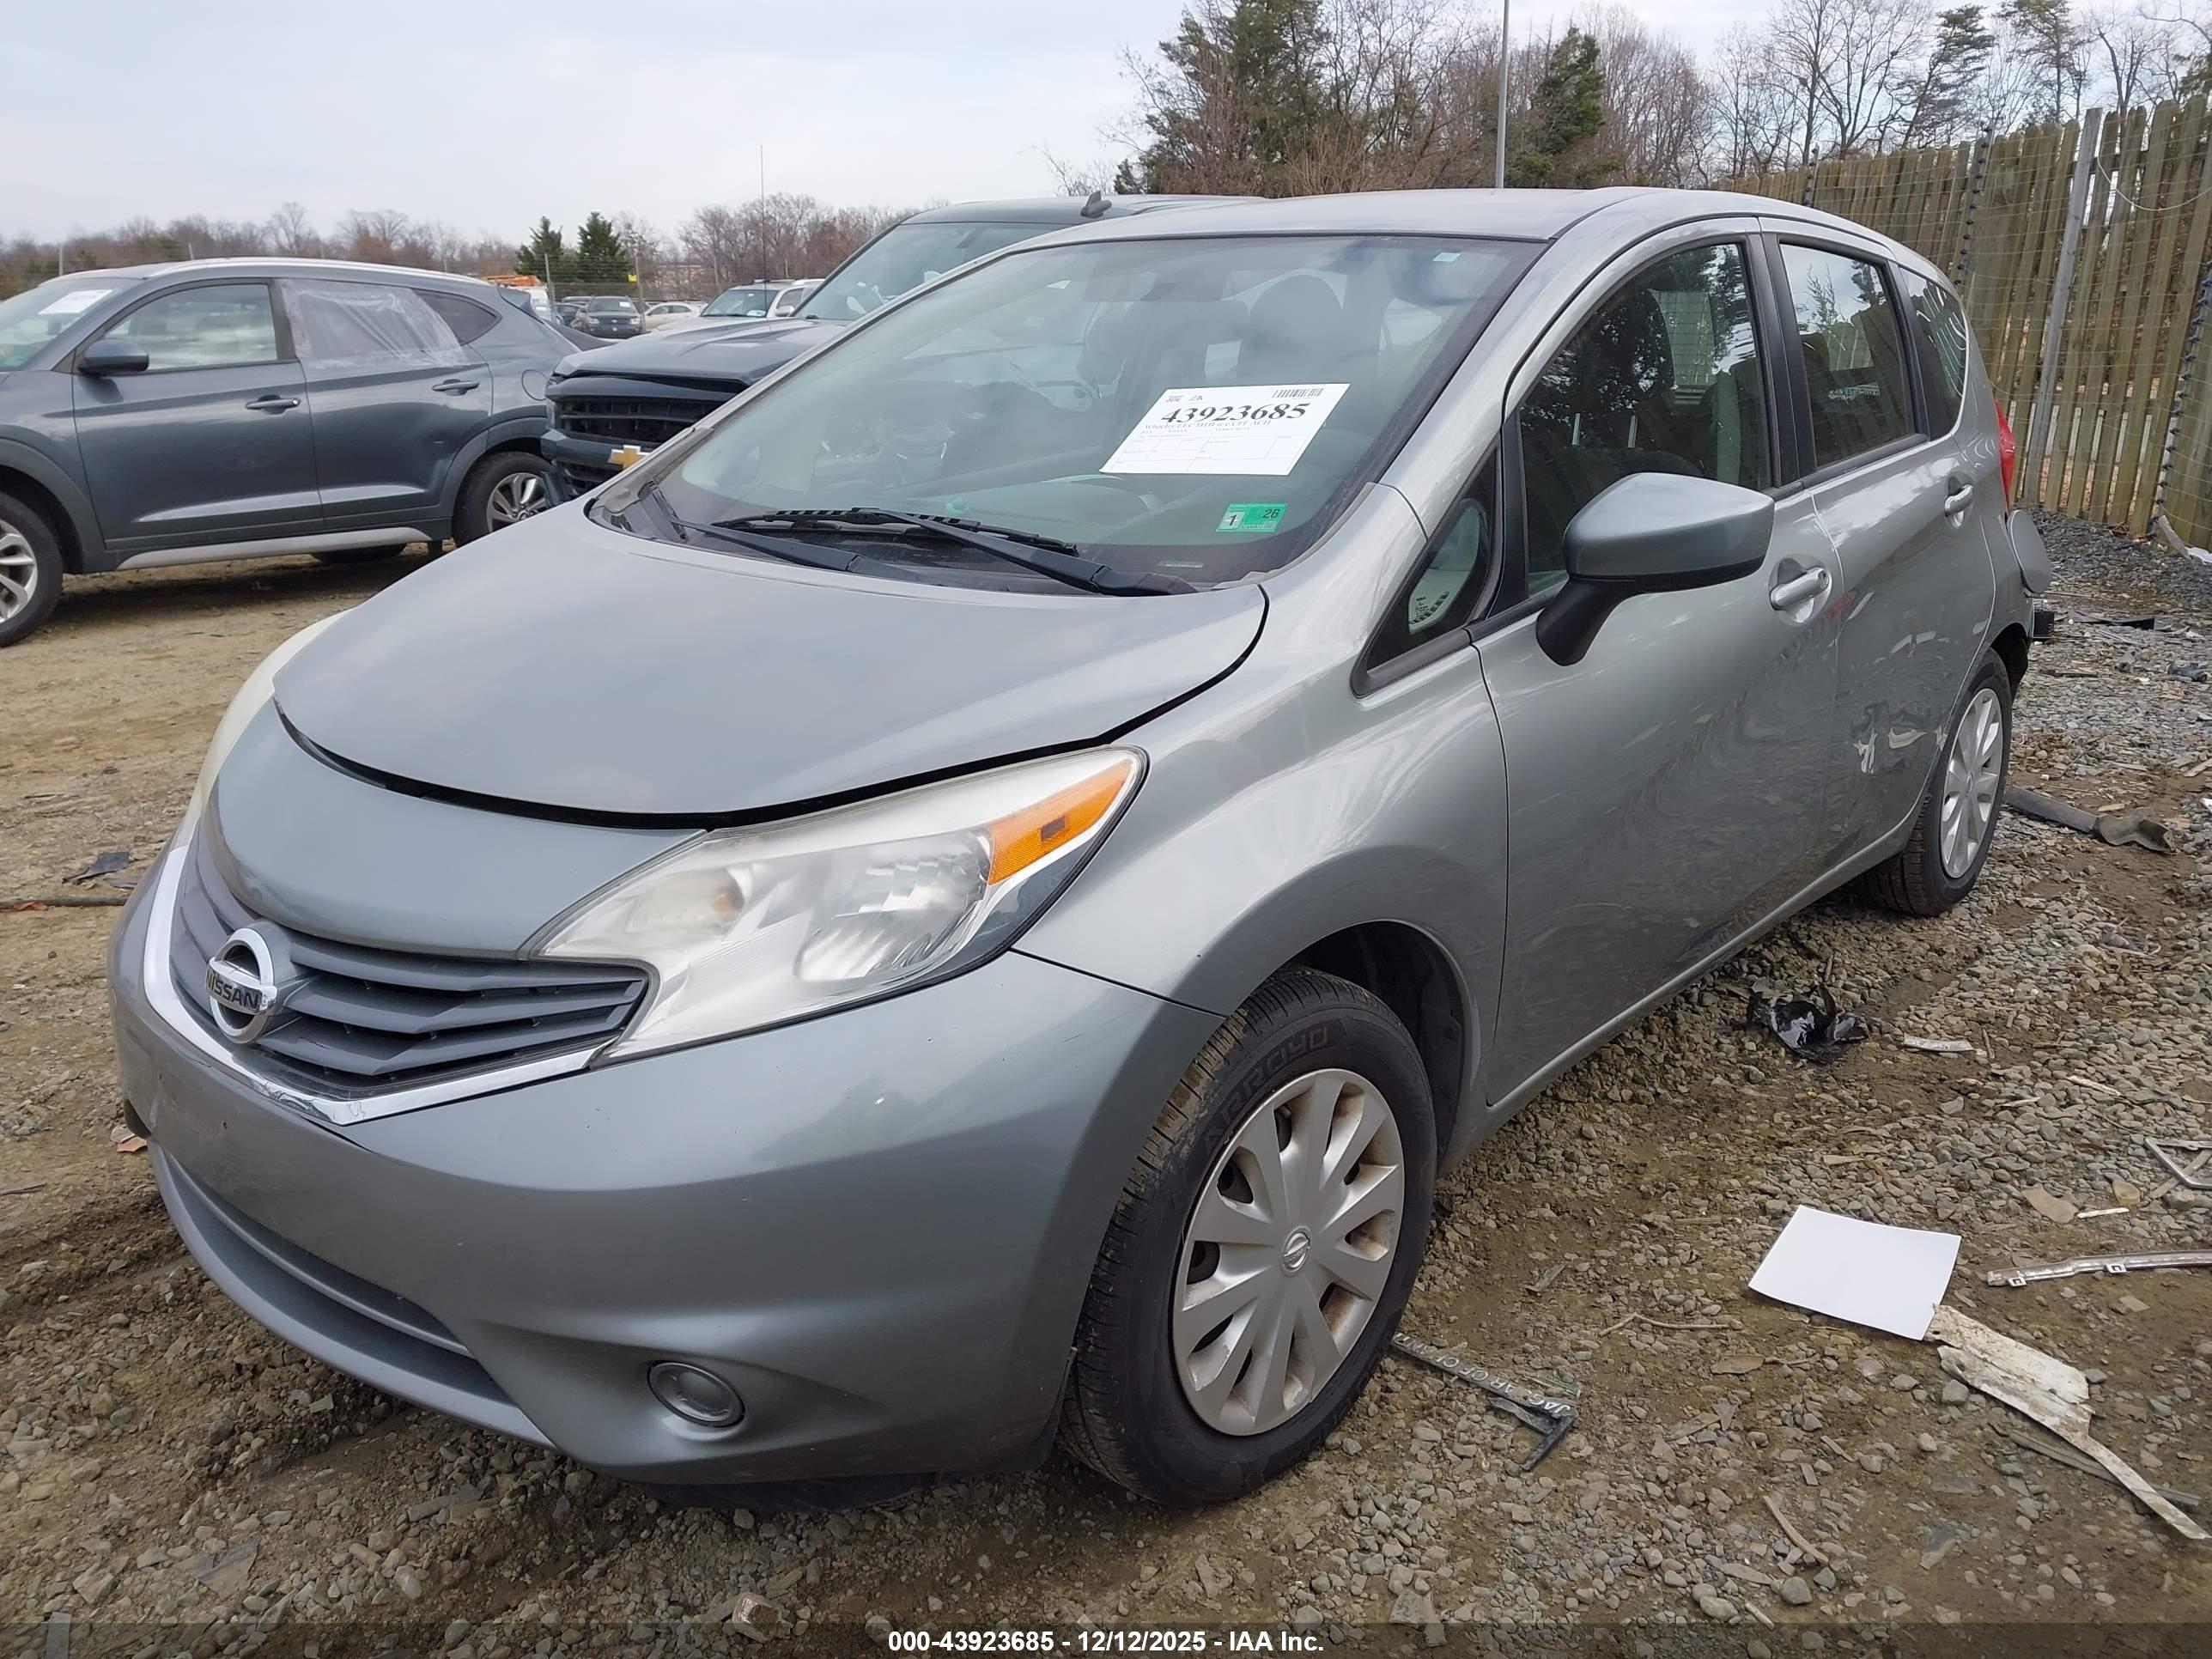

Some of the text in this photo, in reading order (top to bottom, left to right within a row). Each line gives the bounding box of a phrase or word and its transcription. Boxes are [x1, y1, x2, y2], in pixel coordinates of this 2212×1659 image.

[1160, 403, 1311, 423] 43923685
[1229, 514, 1237, 526] 1
[1262, 508, 1280, 519] 26
[206, 965, 263, 1013] NISSAN
[1205, 1025, 1329, 1157] ARROYO
[1460, 1365, 1489, 1382] OF
[1490, 1376, 1571, 1416] JAGAR
